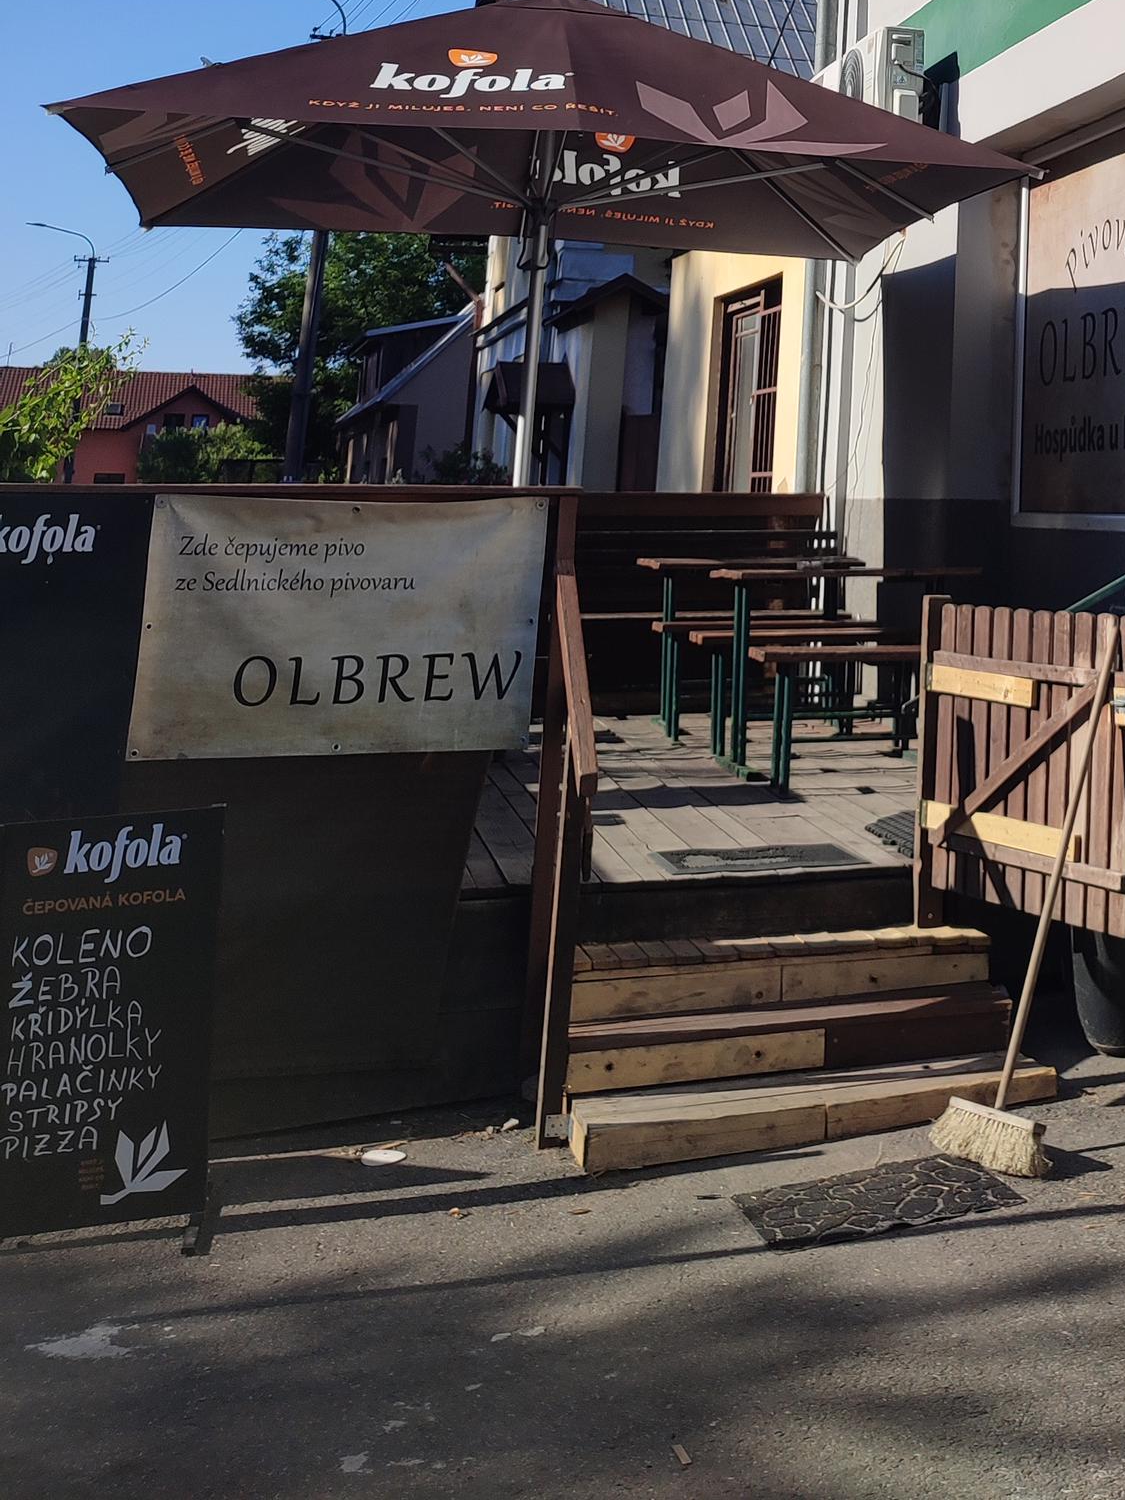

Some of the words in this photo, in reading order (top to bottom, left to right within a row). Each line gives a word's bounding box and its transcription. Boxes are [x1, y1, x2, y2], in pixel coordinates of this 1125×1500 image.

[369, 62, 567, 98] kofola
[308, 99, 360, 109] KDYŽ
[531, 103, 558, 111] CO
[1034, 414, 1105, 462] Hospůdka
[1109, 430, 1118, 450] u
[178, 534, 218, 556] Zde
[224, 535, 318, 564] čepujeme
[324, 537, 365, 563] pivo
[175, 577, 197, 592] ze
[202, 568, 324, 592] Sedlnického
[330, 571, 416, 598] pivovaru
[233, 650, 522, 707] OLBREW
[64, 823, 183, 883] kofola
[23, 891, 113, 915] ČEPOVANÁ
[118, 888, 186, 906] KOFOLA
[12, 925, 152, 967] KOLENO
[9, 966, 121, 1009] ŽEBRA
[7, 1027, 161, 1076] HRANOLKY
[1, 1064, 162, 1105] PALAČINKY
[8, 1097, 122, 1132] STRIPSY
[0, 1126, 98, 1159] PIZZA
